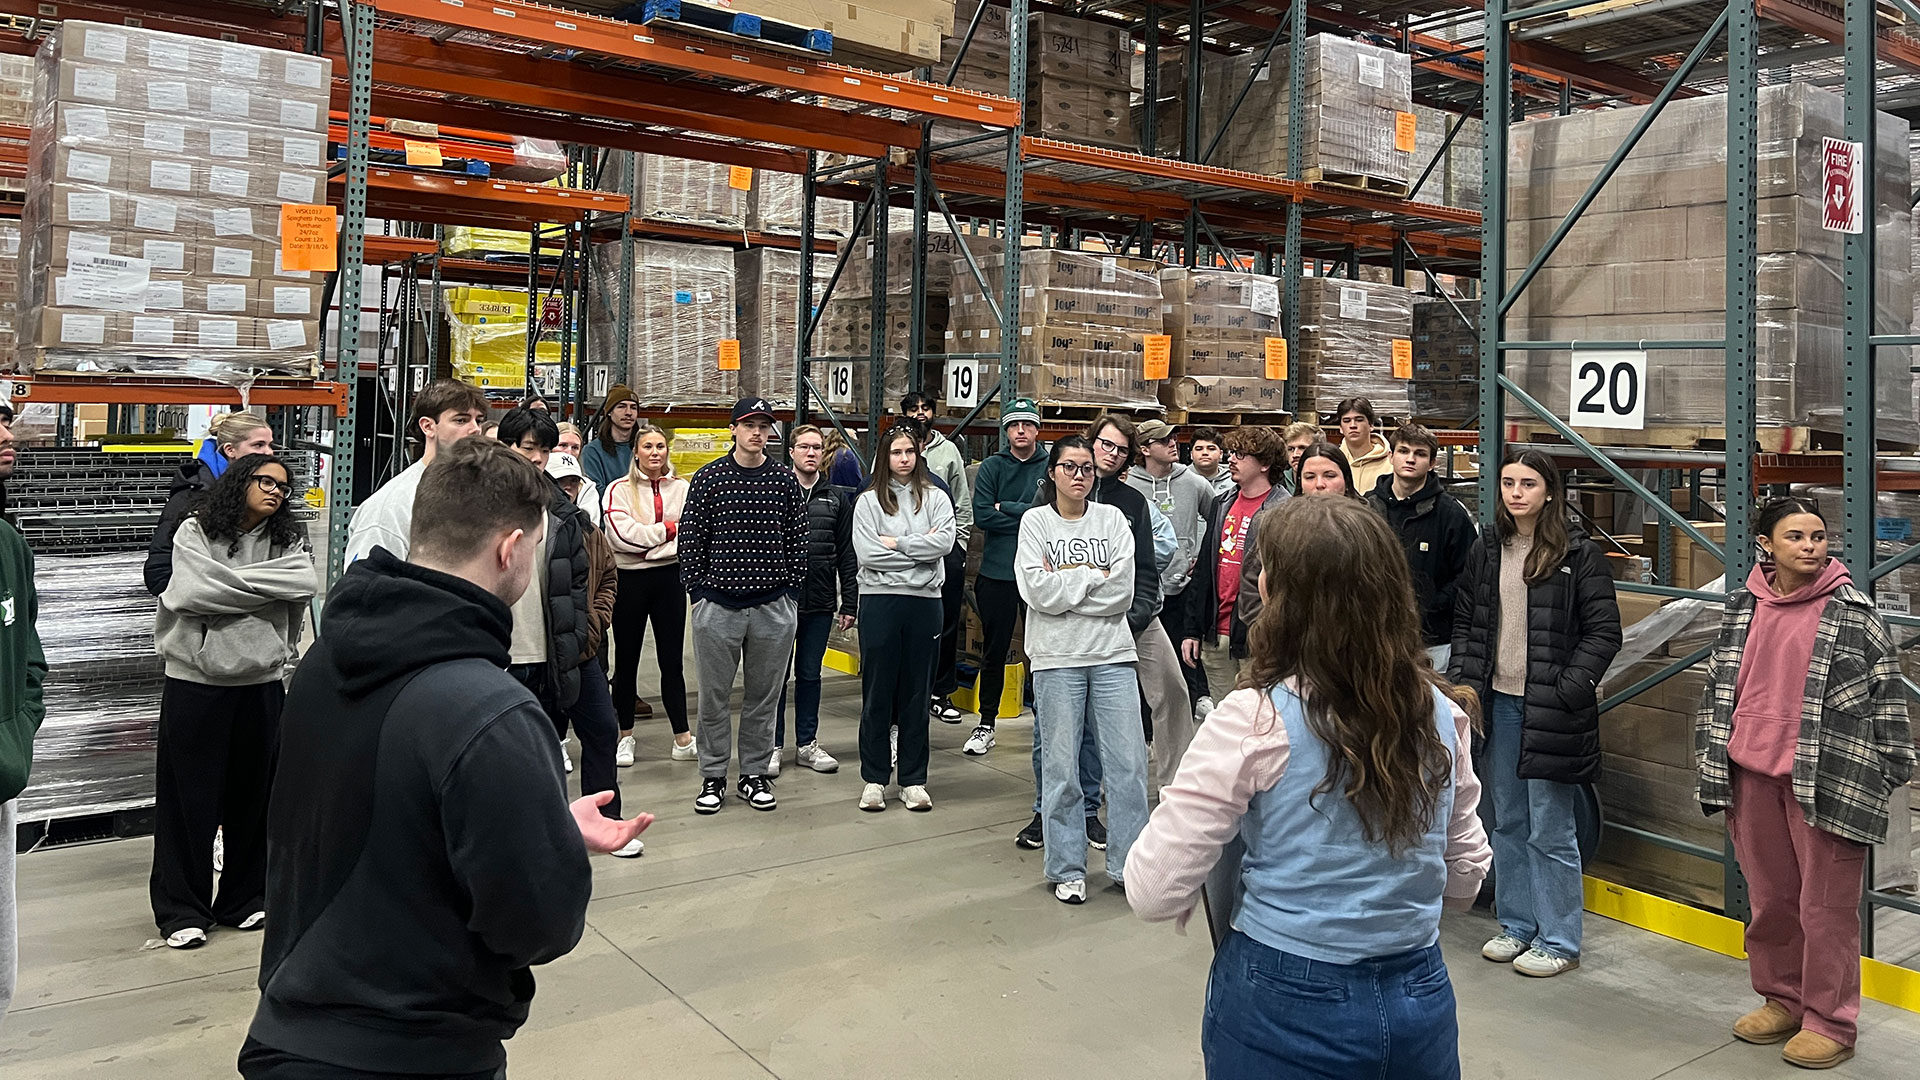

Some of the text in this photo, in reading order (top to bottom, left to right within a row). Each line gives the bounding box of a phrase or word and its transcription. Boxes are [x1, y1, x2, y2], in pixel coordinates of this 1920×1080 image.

[1052, 36, 1080, 56] 5241
[1831, 152, 1848, 167] FIRE
[547, 369, 555, 390] 16
[596, 369, 606, 391] 17
[832, 366, 849, 396] 18
[952, 366, 973, 399] 19
[1577, 361, 1638, 416] 20
[1047, 538, 1111, 568] MSU
